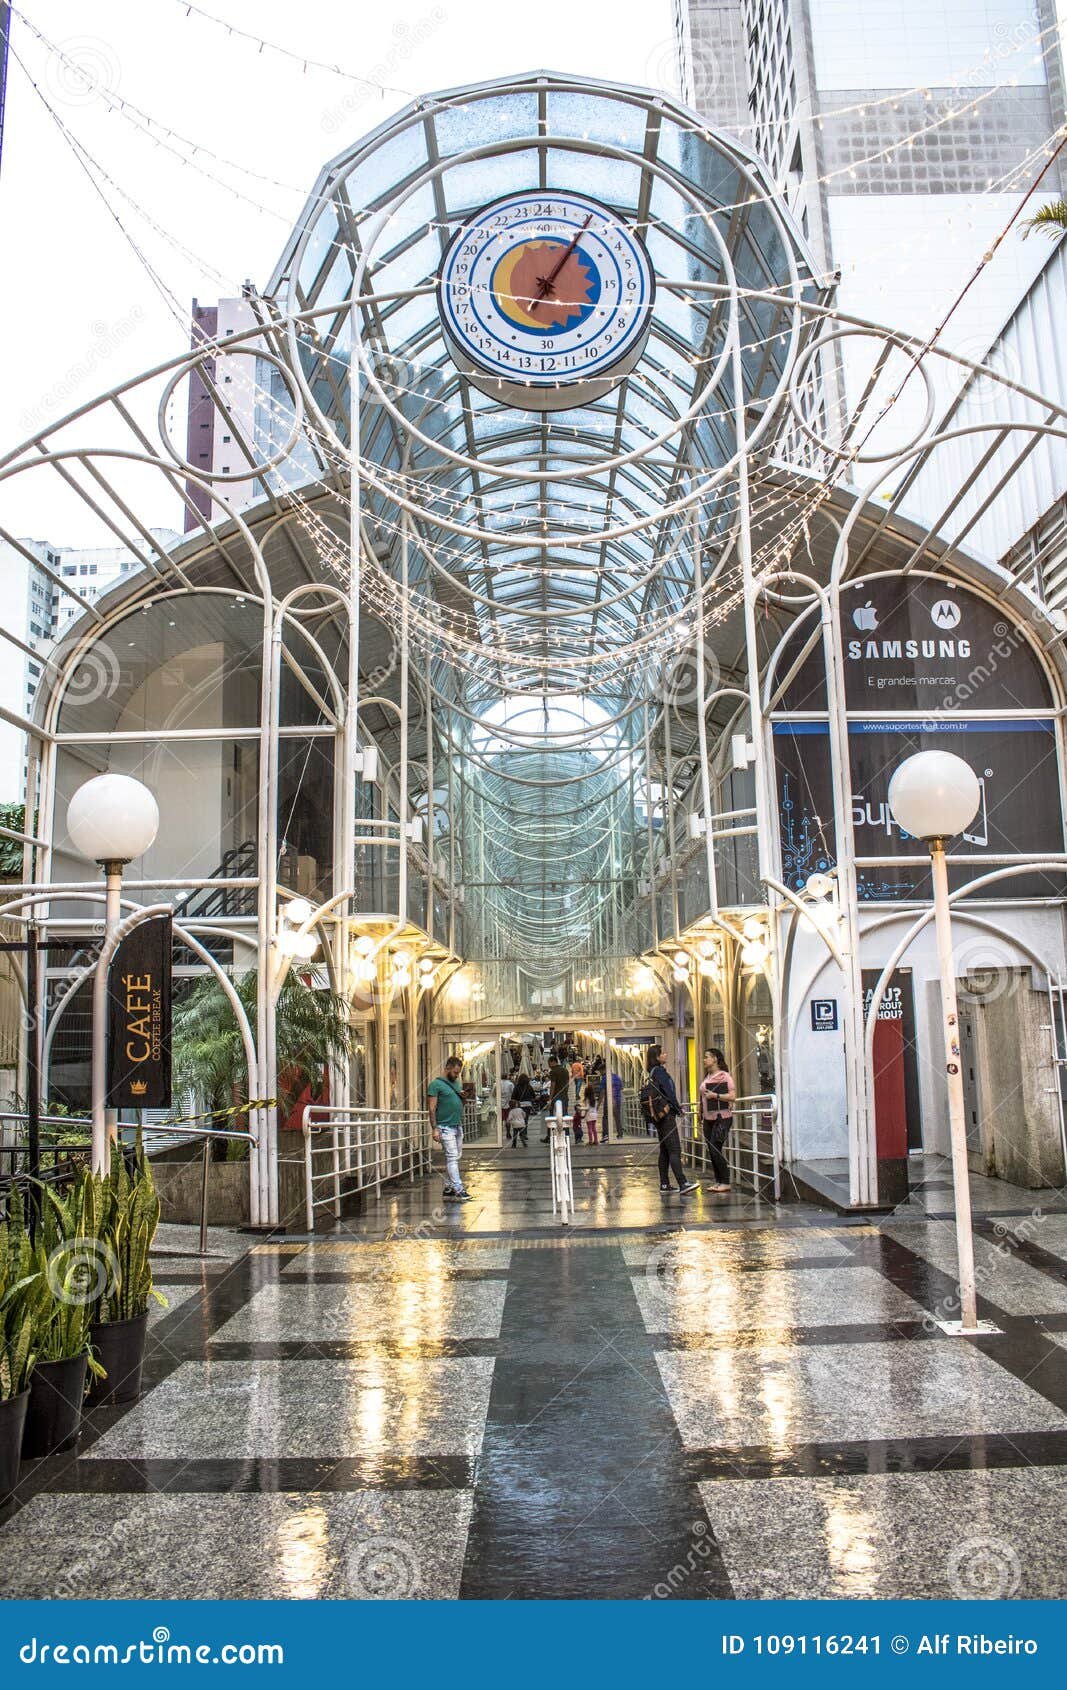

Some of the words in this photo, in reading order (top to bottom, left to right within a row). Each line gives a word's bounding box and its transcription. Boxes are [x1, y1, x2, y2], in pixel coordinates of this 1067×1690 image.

[514, 207, 528, 218] 23
[534, 203, 553, 216] 24
[562, 207, 567, 217] 1
[494, 216, 508, 226] 22
[477, 229, 490, 239] 21
[463, 245, 478, 255] 20
[614, 240, 622, 251] 4
[455, 263, 468, 274] 19
[624, 259, 631, 270] 5
[452, 282, 467, 296] 18
[604, 279, 616, 289] 15
[626, 277, 637, 291] 6
[455, 303, 469, 314] 17
[464, 322, 478, 333] 16
[617, 317, 626, 329] 8
[479, 338, 492, 349] 15
[540, 340, 554, 350] 30
[604, 334, 613, 345] 9
[496, 350, 510, 361] 14
[584, 347, 598, 358] 10
[518, 356, 532, 368] 13
[540, 357, 557, 372] 12
[563, 355, 576, 367] 11
[848, 639, 971, 660] SAMSUNG
[867, 676, 874, 686] E
[877, 675, 917, 689] grandes
[919, 676, 957, 685] marcas
[152, 989, 161, 1021] BREAK
[121, 973, 152, 1063] CAFÉ
[152, 1022, 161, 1061] COFFEE
